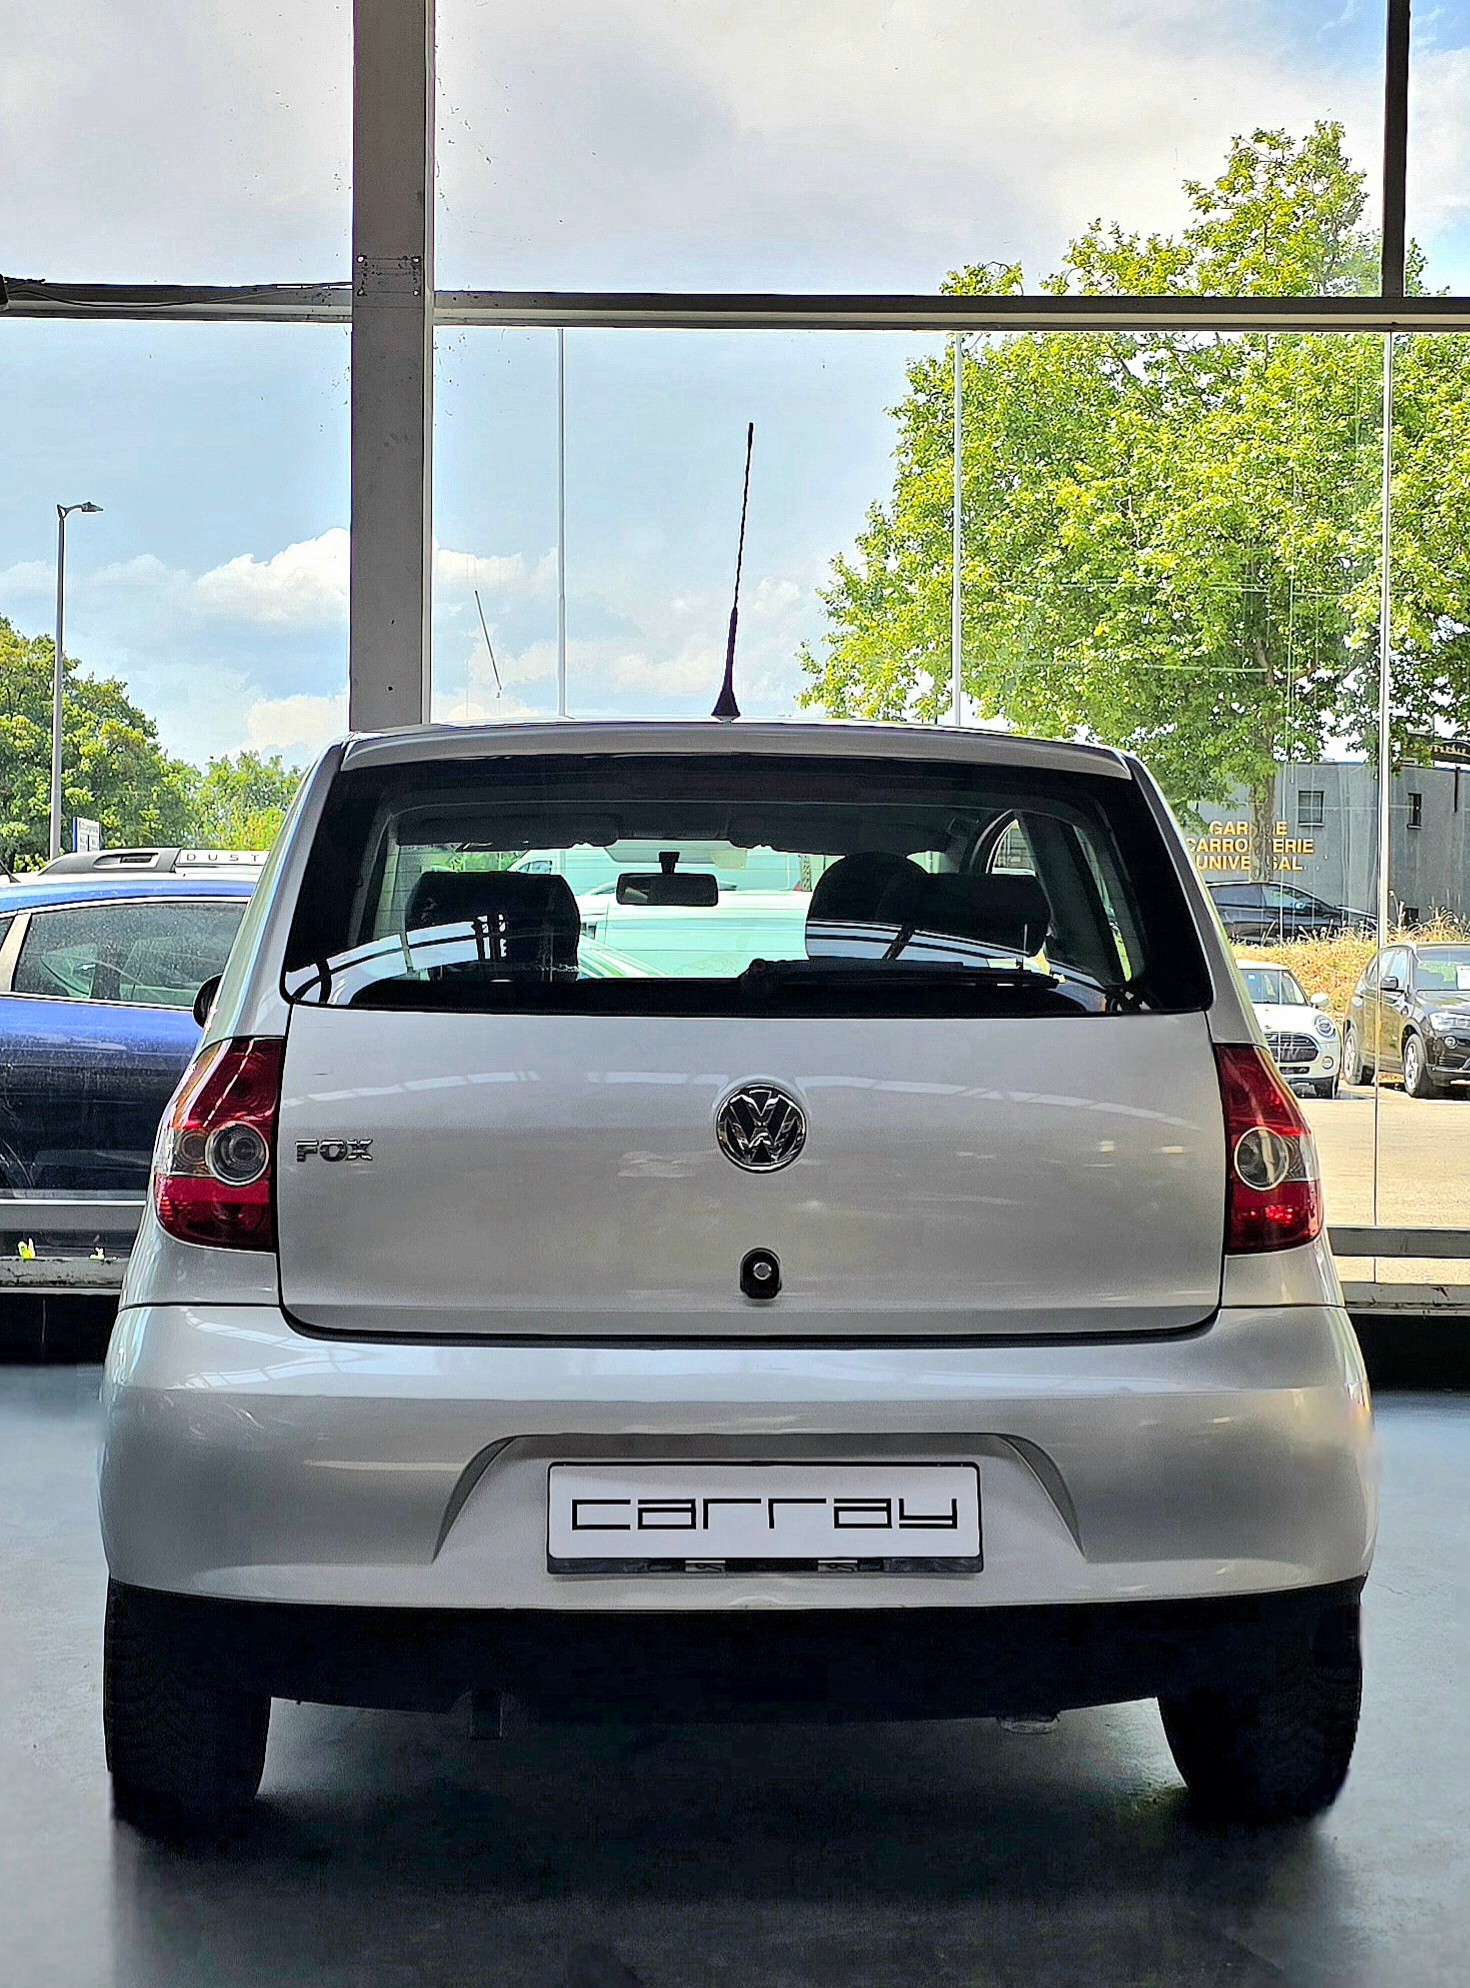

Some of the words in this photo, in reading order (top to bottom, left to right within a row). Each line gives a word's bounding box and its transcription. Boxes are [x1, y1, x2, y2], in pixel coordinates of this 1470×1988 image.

[1209, 820, 1288, 836] GARE
[1186, 838, 1314, 854] CARROERIE
[294, 1139, 373, 1162] FOX
[571, 1498, 957, 1530] carray
